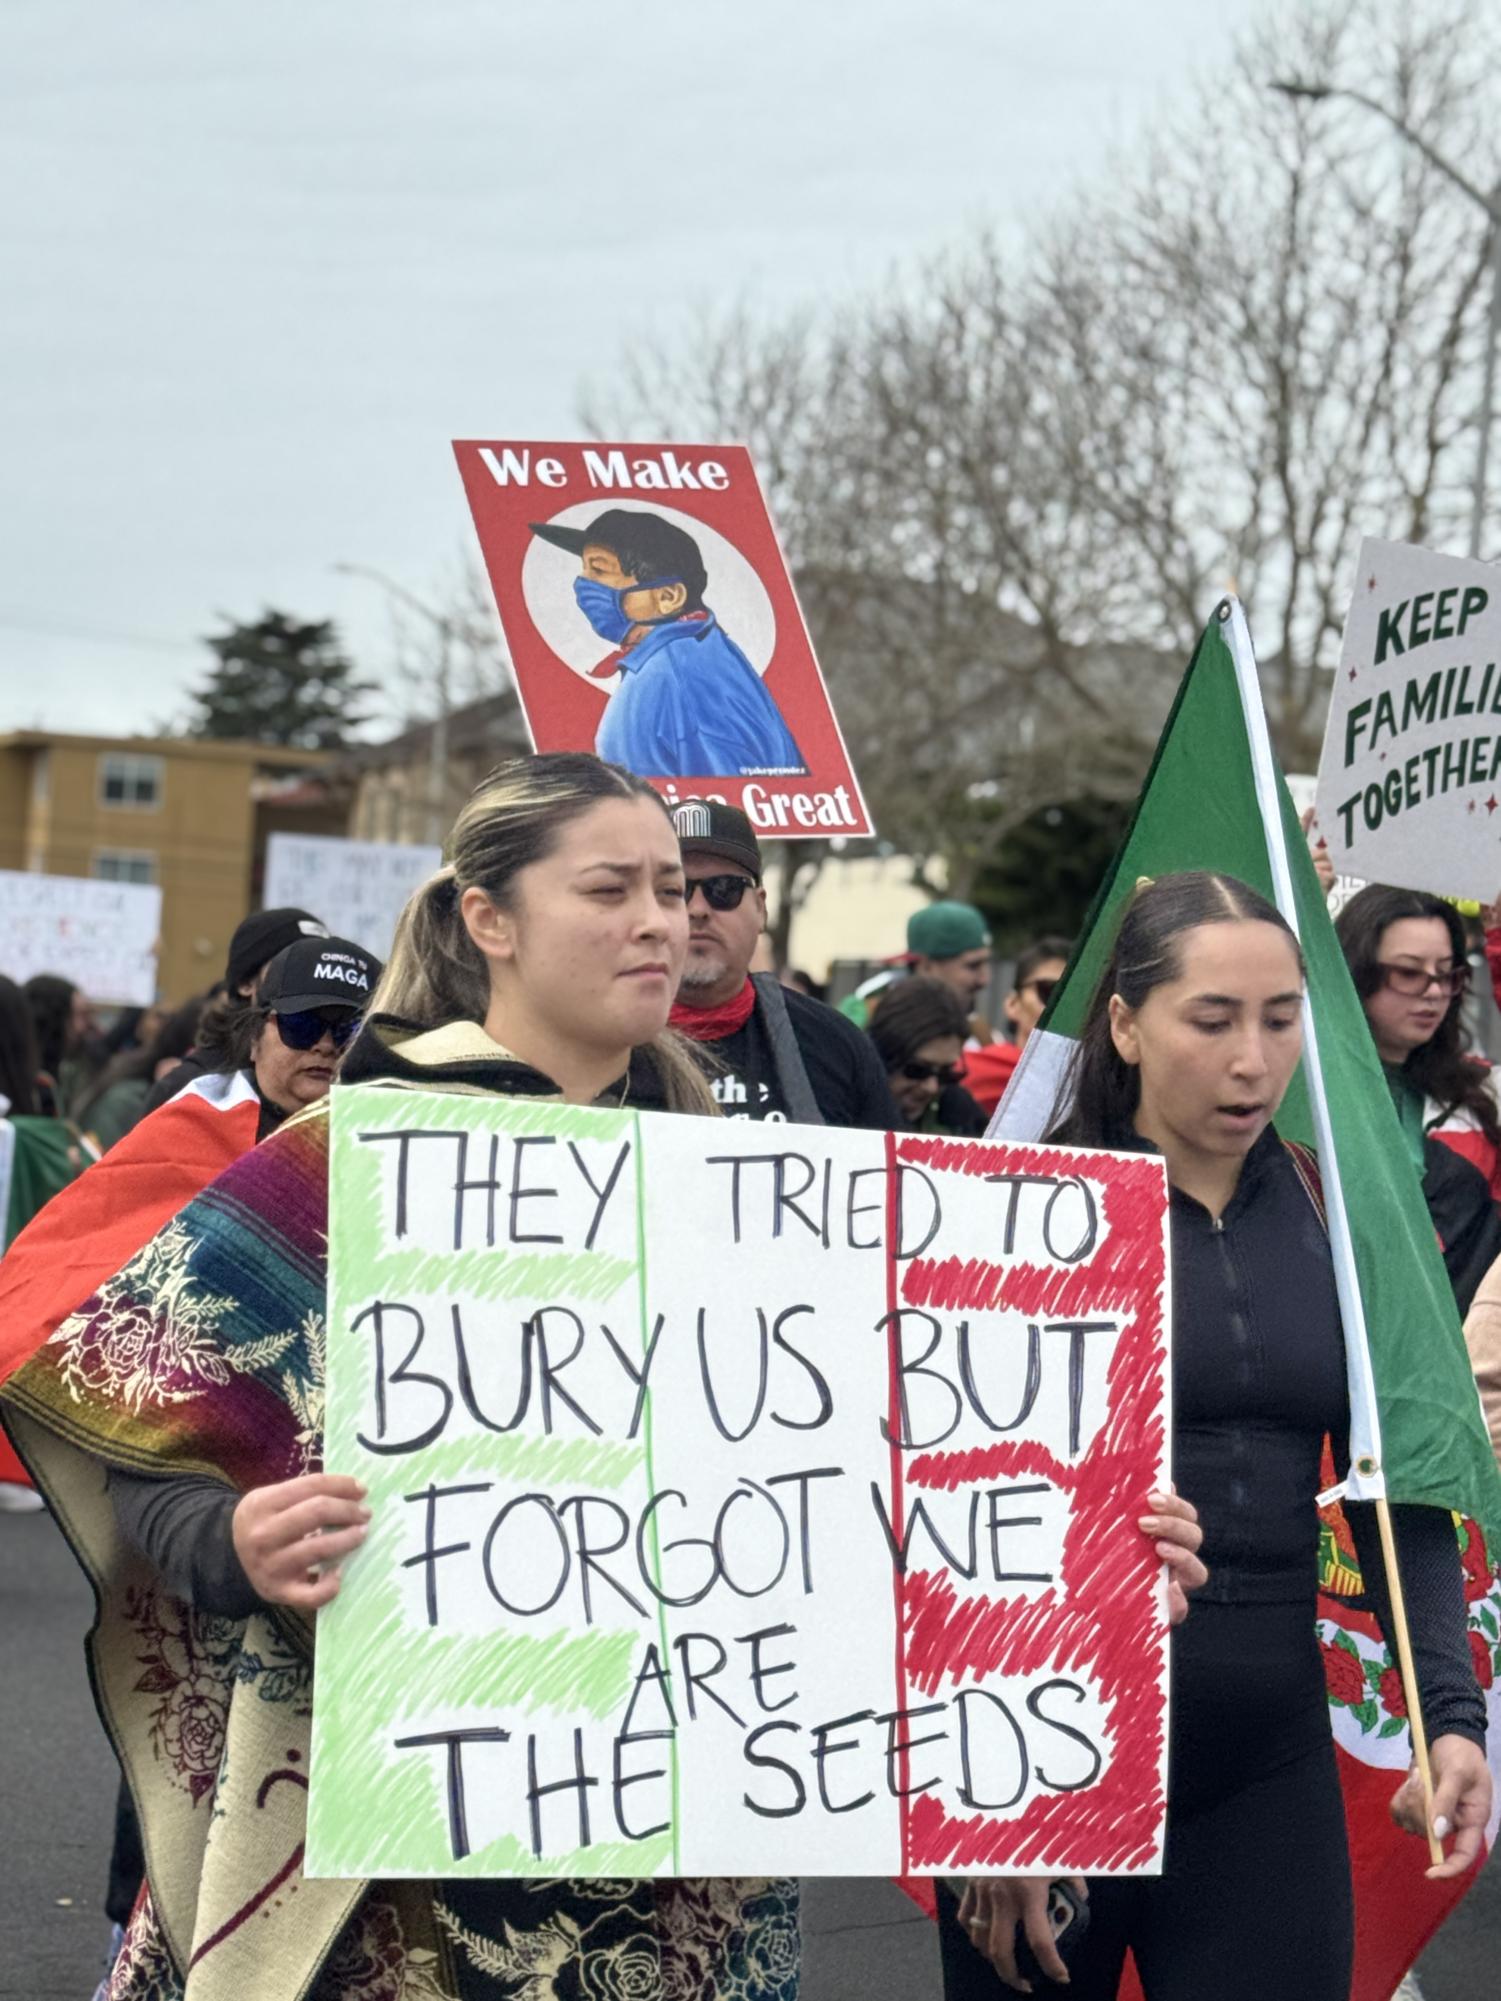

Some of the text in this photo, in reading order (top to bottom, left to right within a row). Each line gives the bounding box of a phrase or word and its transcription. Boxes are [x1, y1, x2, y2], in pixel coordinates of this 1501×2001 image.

[478, 448, 730, 491] We Make
[1374, 586, 1489, 666] KEEP
[742, 783, 858, 828] Great
[314, 964, 369, 991] MAGA
[358, 1129, 1098, 1264] THEY TRIED TO
[350, 1300, 1118, 1459] BURY US BUT
[401, 1466, 1053, 1627] FORGOT WE
[620, 1622, 799, 1738] ARE
[394, 1677, 1102, 1862] THE SEEDS
